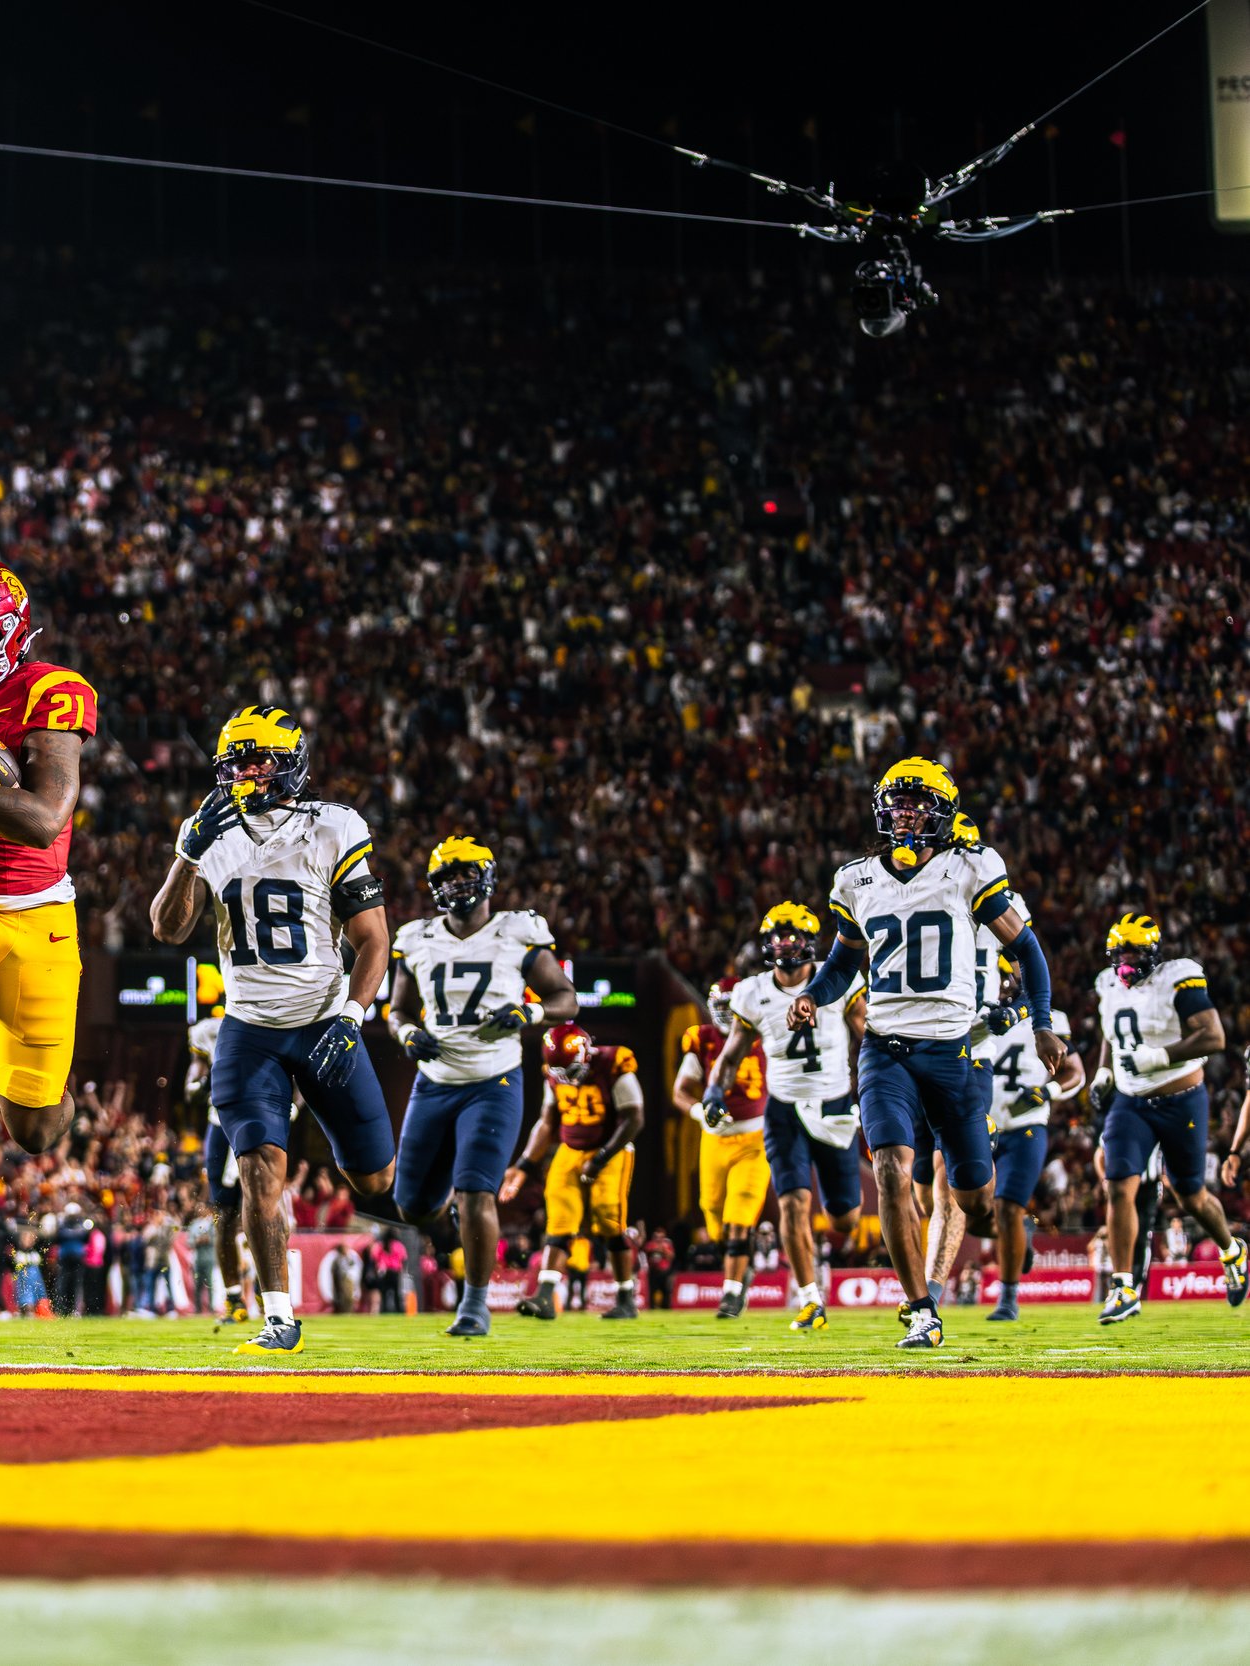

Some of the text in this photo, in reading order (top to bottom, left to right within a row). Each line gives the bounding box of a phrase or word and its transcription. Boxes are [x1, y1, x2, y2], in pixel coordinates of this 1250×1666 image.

[47, 693, 84, 730] 21
[222, 877, 308, 966] 18
[865, 909, 954, 993] 20
[430, 961, 493, 1026] 17
[786, 1017, 822, 1073] 4
